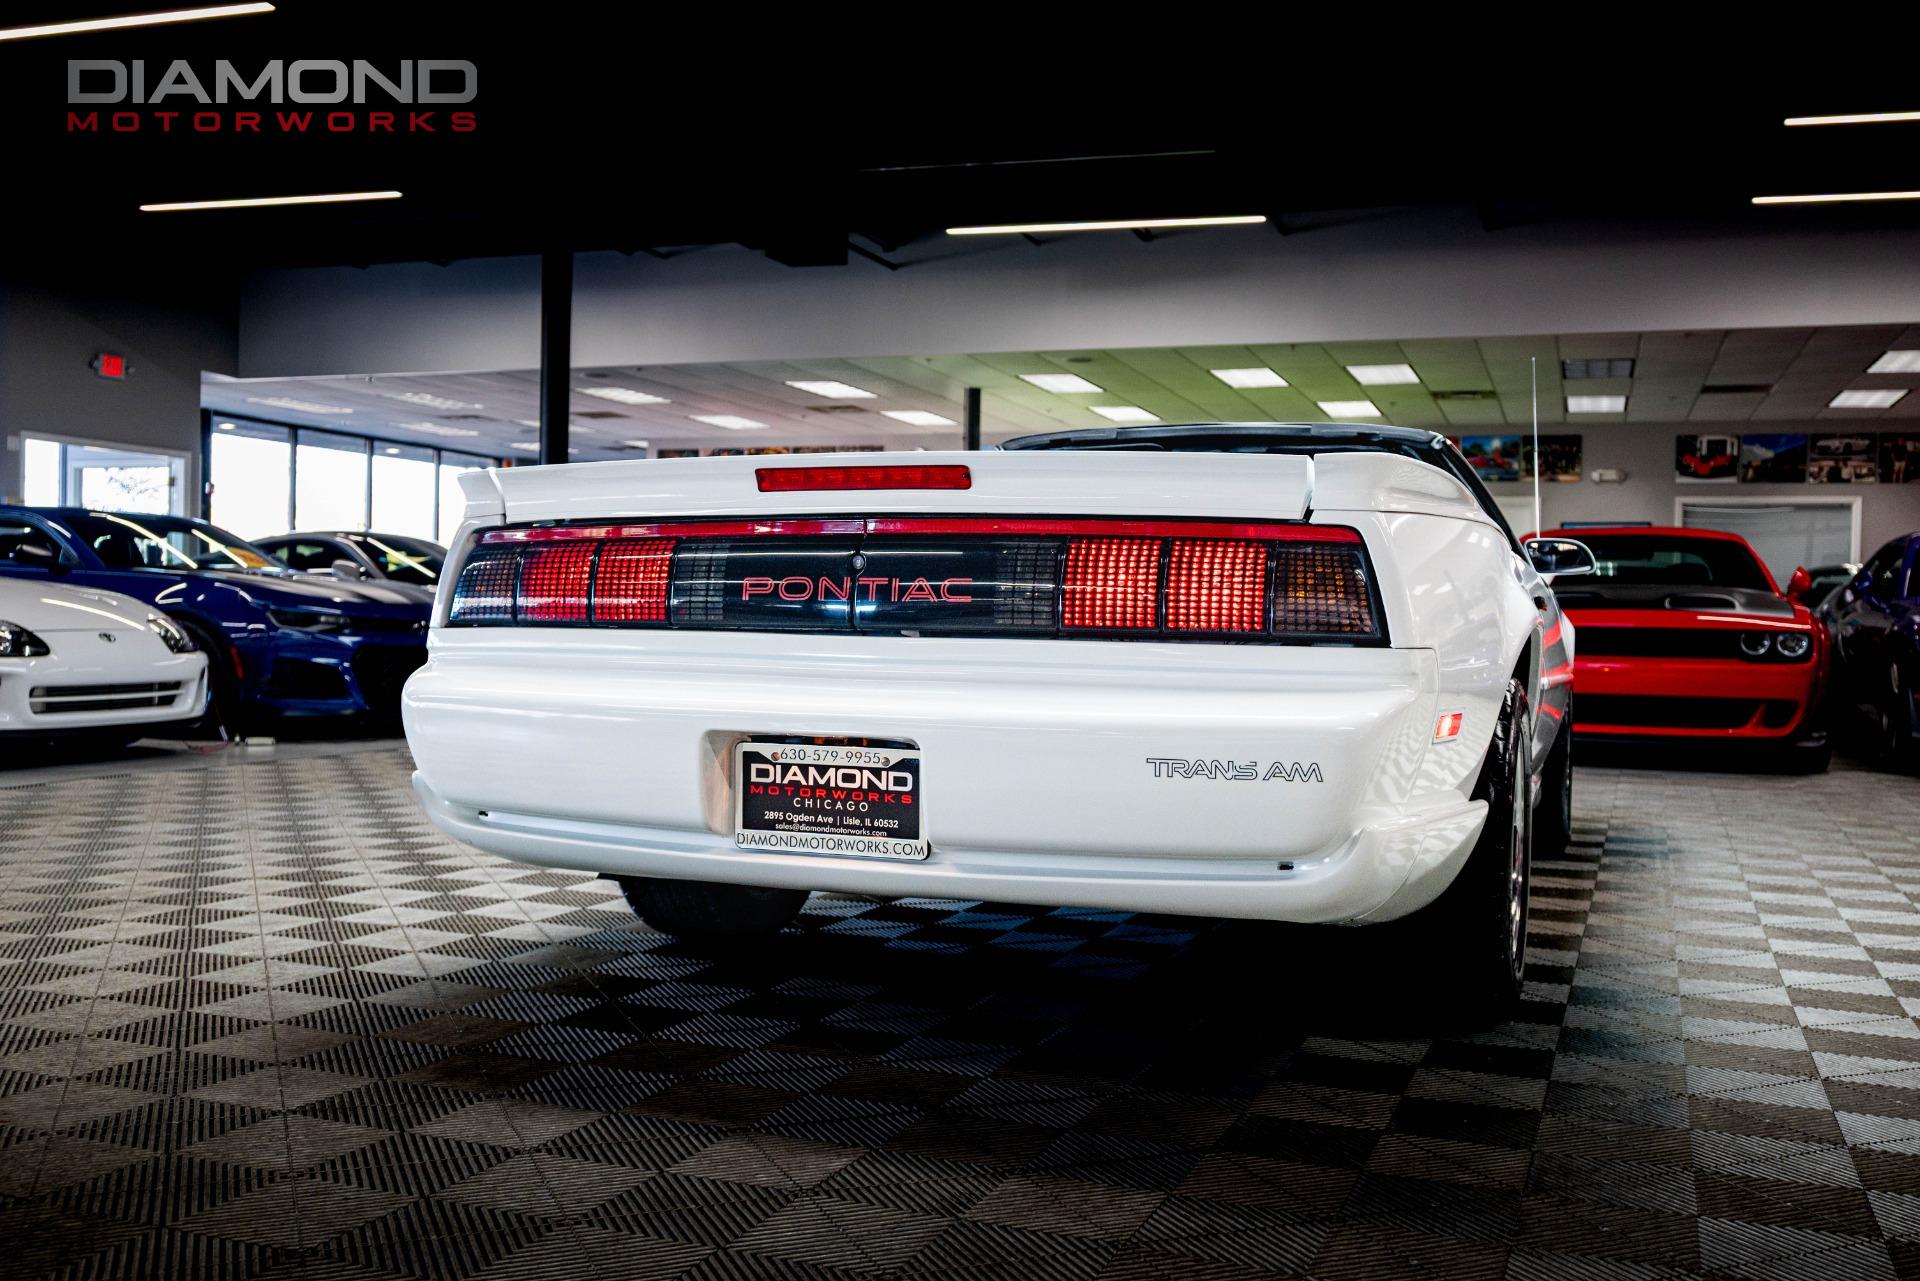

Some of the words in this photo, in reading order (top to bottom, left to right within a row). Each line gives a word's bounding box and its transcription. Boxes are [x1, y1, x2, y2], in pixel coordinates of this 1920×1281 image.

[742, 576, 973, 603] PONTIAC
[780, 748, 881, 764] 630-579-9955
[750, 763, 913, 792] DIAMOND
[1146, 758, 1258, 780] TRANS
[1262, 762, 1324, 783] AM
[750, 785, 913, 804] MOTORWORKS
[793, 797, 869, 812] CHICAGO
[764, 811, 784, 821] 2895
[786, 812, 815, 824] Ogden
[817, 814, 833, 824] Ave
[843, 816, 863, 827] Lisle,
[865, 817, 872, 827] IL
[874, 818, 899, 829] 60532
[775, 823, 888, 837] sales@diamondmotorworks.com
[736, 832, 925, 857] DIAMONDMOTORWORKS.COM
